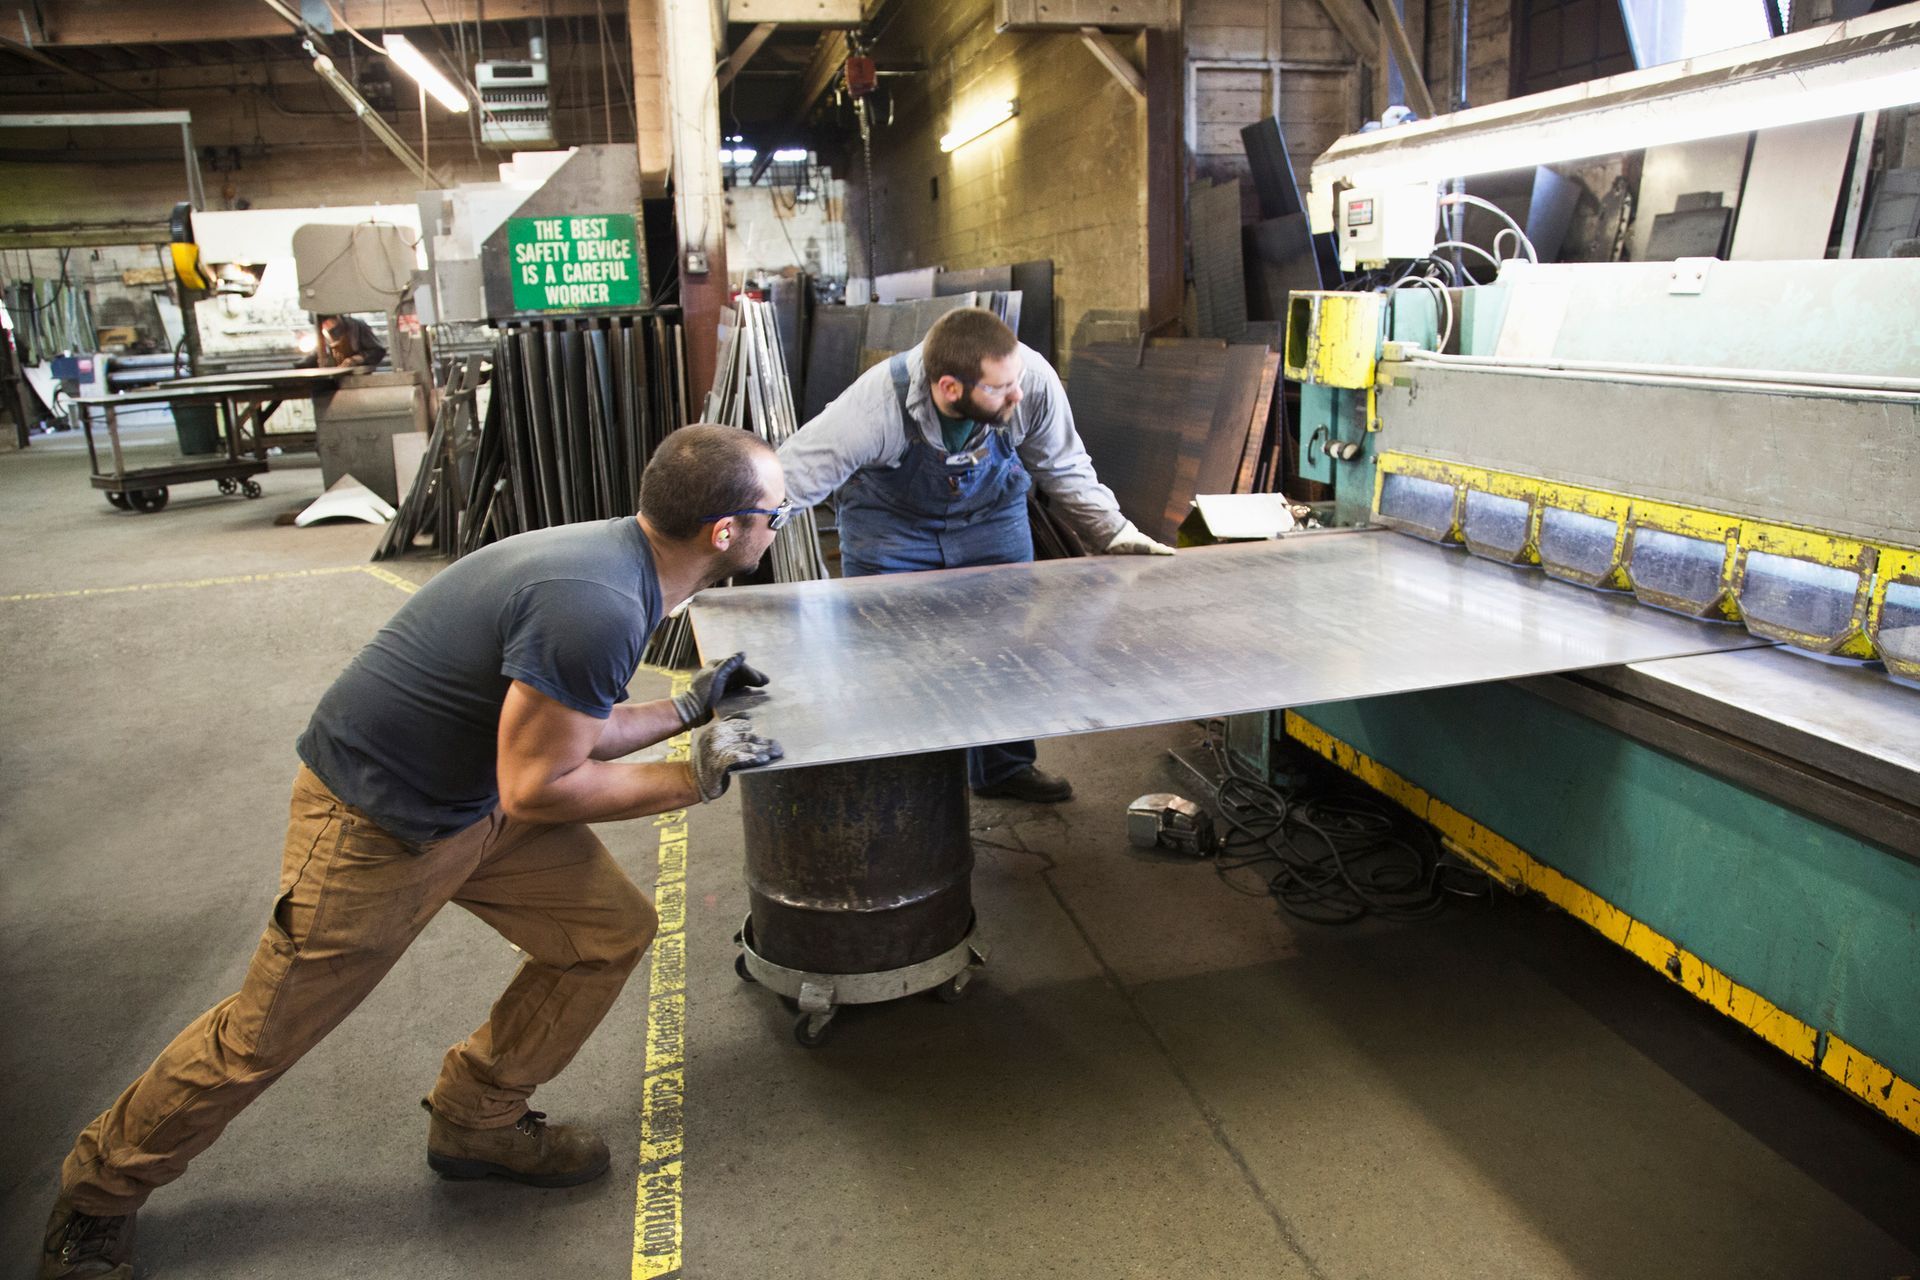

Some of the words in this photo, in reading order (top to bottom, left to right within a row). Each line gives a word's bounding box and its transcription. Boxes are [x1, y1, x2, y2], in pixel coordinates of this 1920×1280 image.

[533, 220, 564, 241] THE
[570, 218, 608, 239] BEST
[515, 241, 570, 263] SAFETY
[577, 239, 631, 261] DEVICE
[522, 264, 539, 285] IS
[545, 263, 556, 284] A
[562, 261, 629, 283] CAREFUL
[544, 283, 610, 305] WORKER
[643, 1175, 677, 1257] CAUTION
